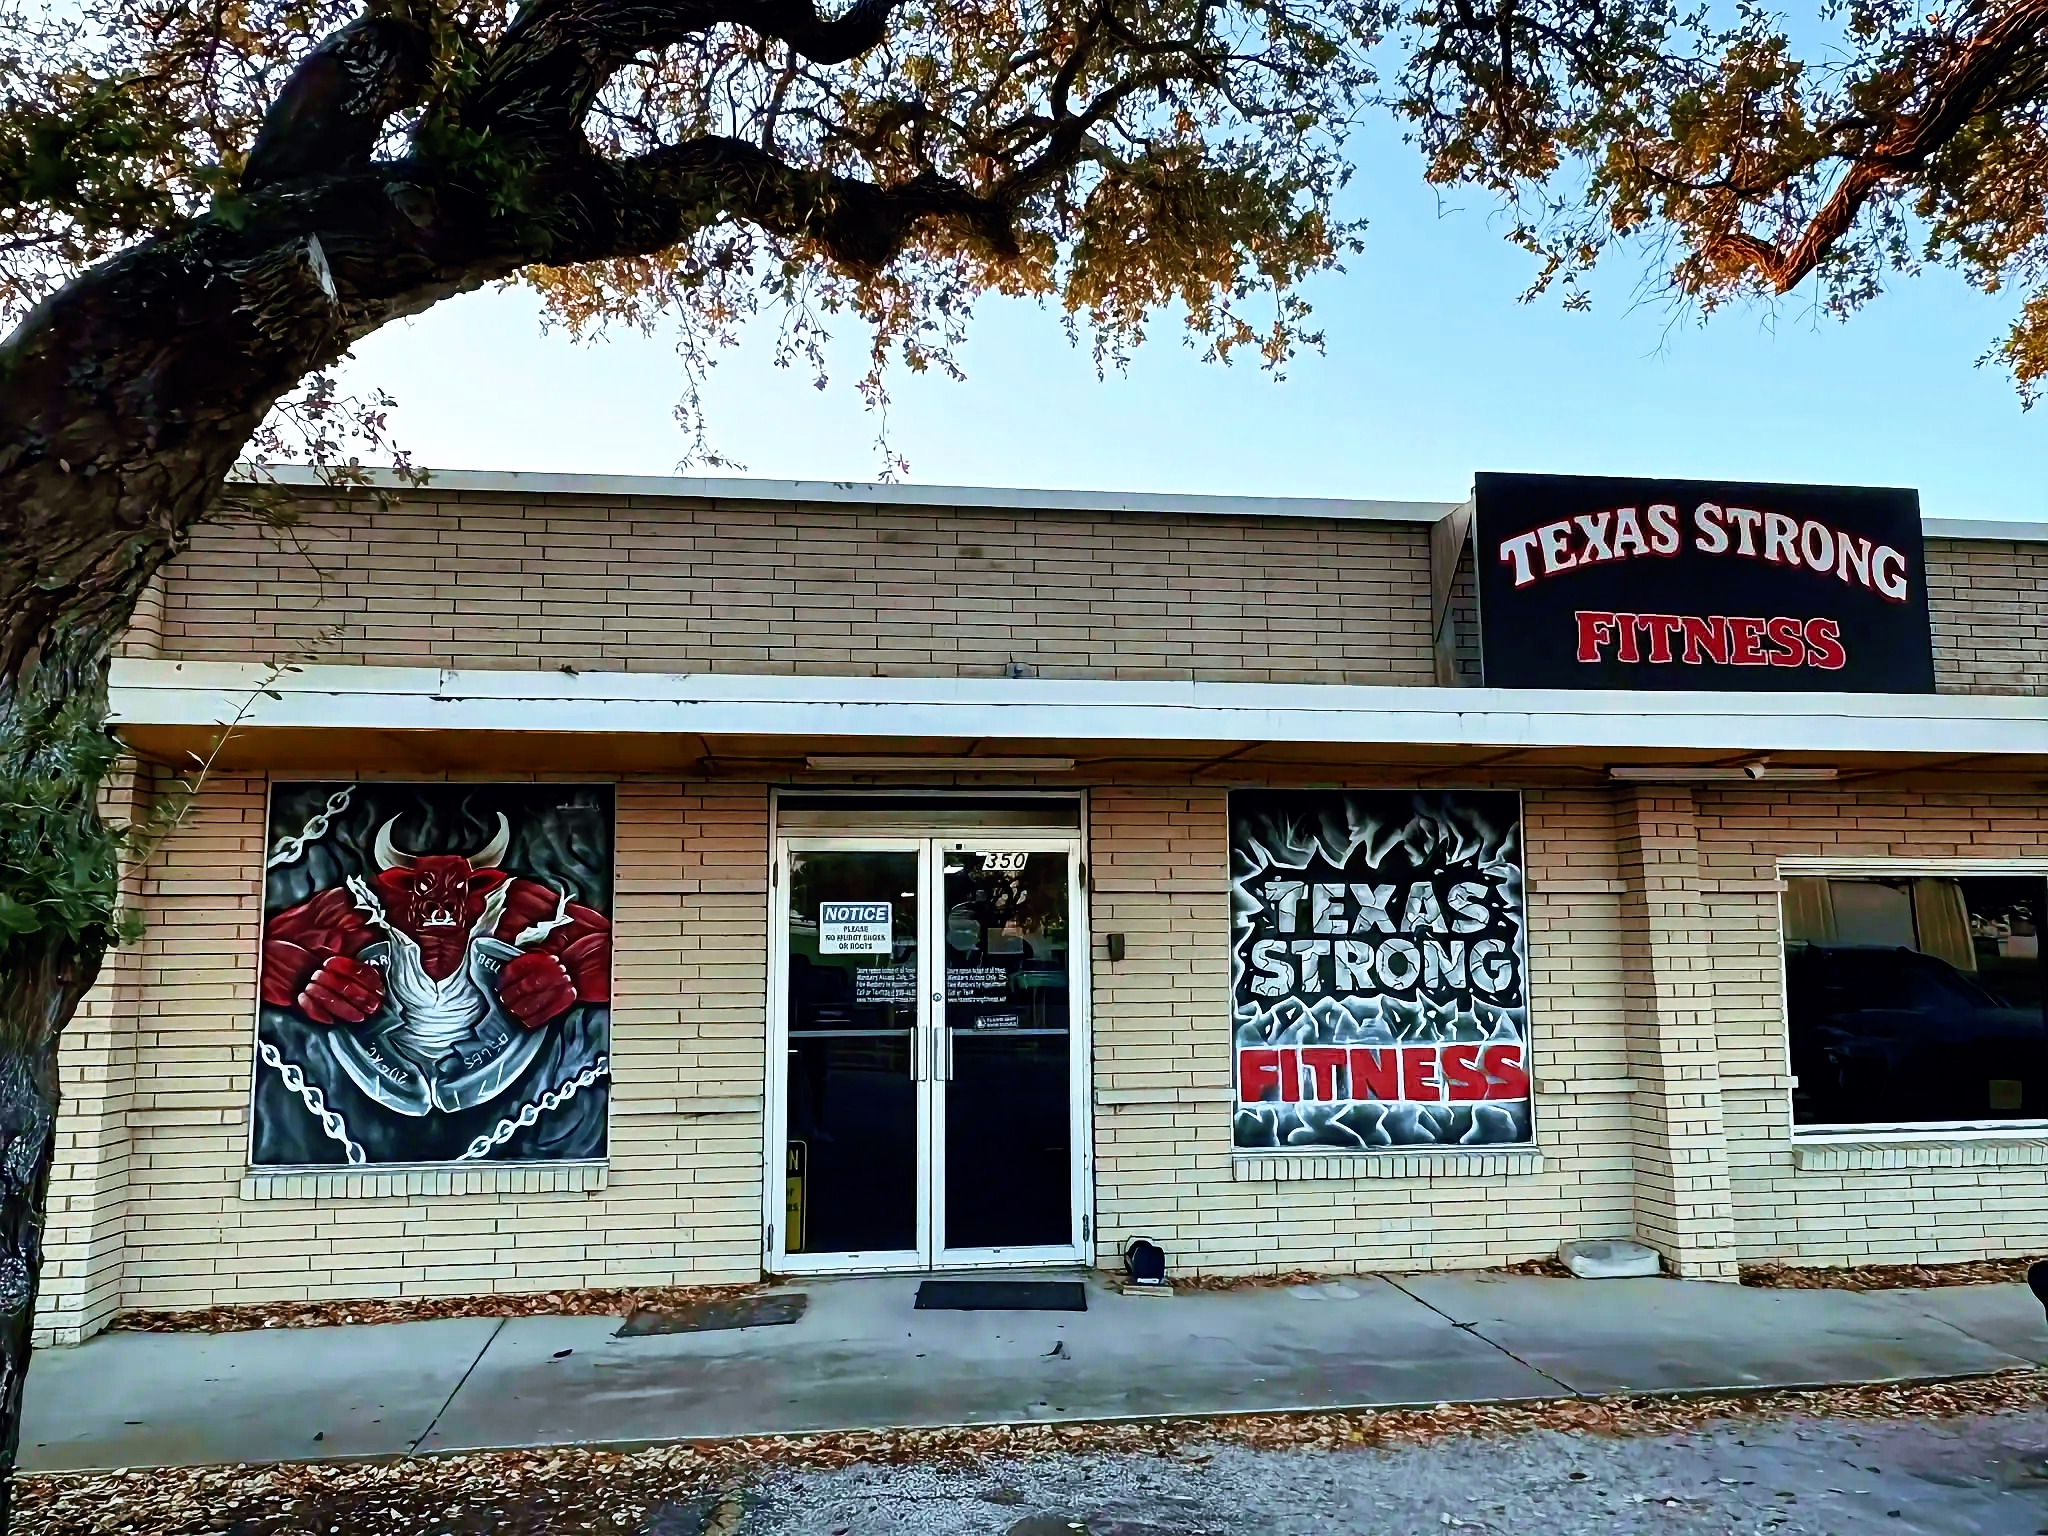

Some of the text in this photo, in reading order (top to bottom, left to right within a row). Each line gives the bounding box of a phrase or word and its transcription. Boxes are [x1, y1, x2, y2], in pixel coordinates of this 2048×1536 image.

[1500, 502, 1908, 601] TEXAS STRONG
[1575, 610, 1847, 670] FITNESS
[986, 853, 1025, 868] 350
[825, 907, 887, 921] NOTICE
[1265, 880, 1490, 934] TEXAS
[1250, 938, 1513, 997] STRONG
[1239, 1045, 1530, 1102] FITNESS
